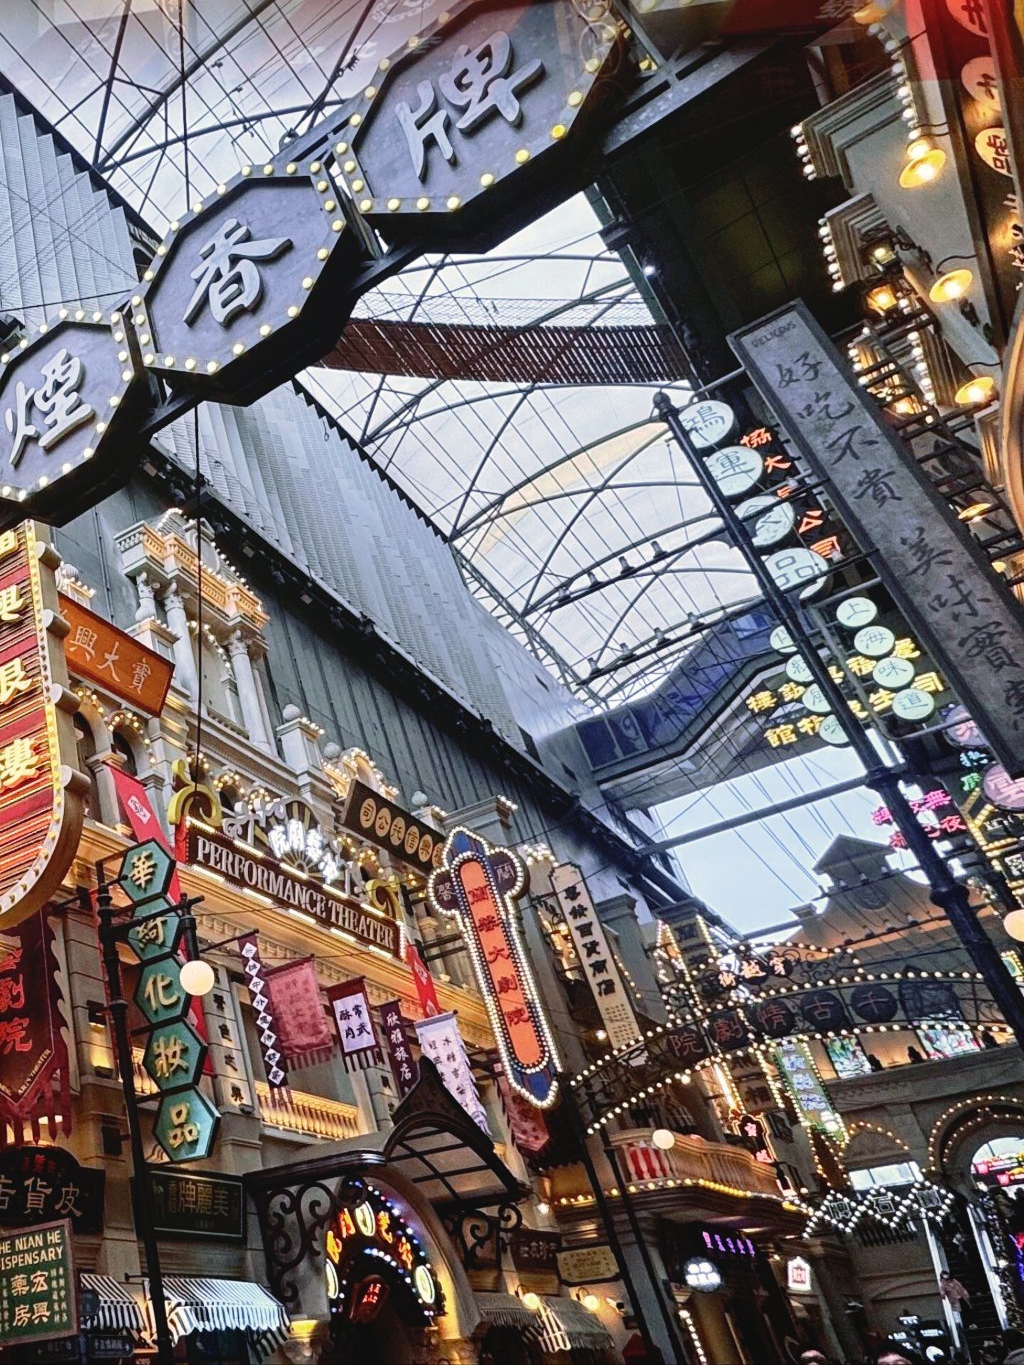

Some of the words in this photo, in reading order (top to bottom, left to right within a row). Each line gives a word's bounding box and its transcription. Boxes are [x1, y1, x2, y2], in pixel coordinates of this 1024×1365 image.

[195, 834, 327, 920] PERFORMANCE
[327, 899, 395, 951] THEATER
[15, 1234, 44, 1251] NIAN
[46, 1230, 63, 1245] HE
